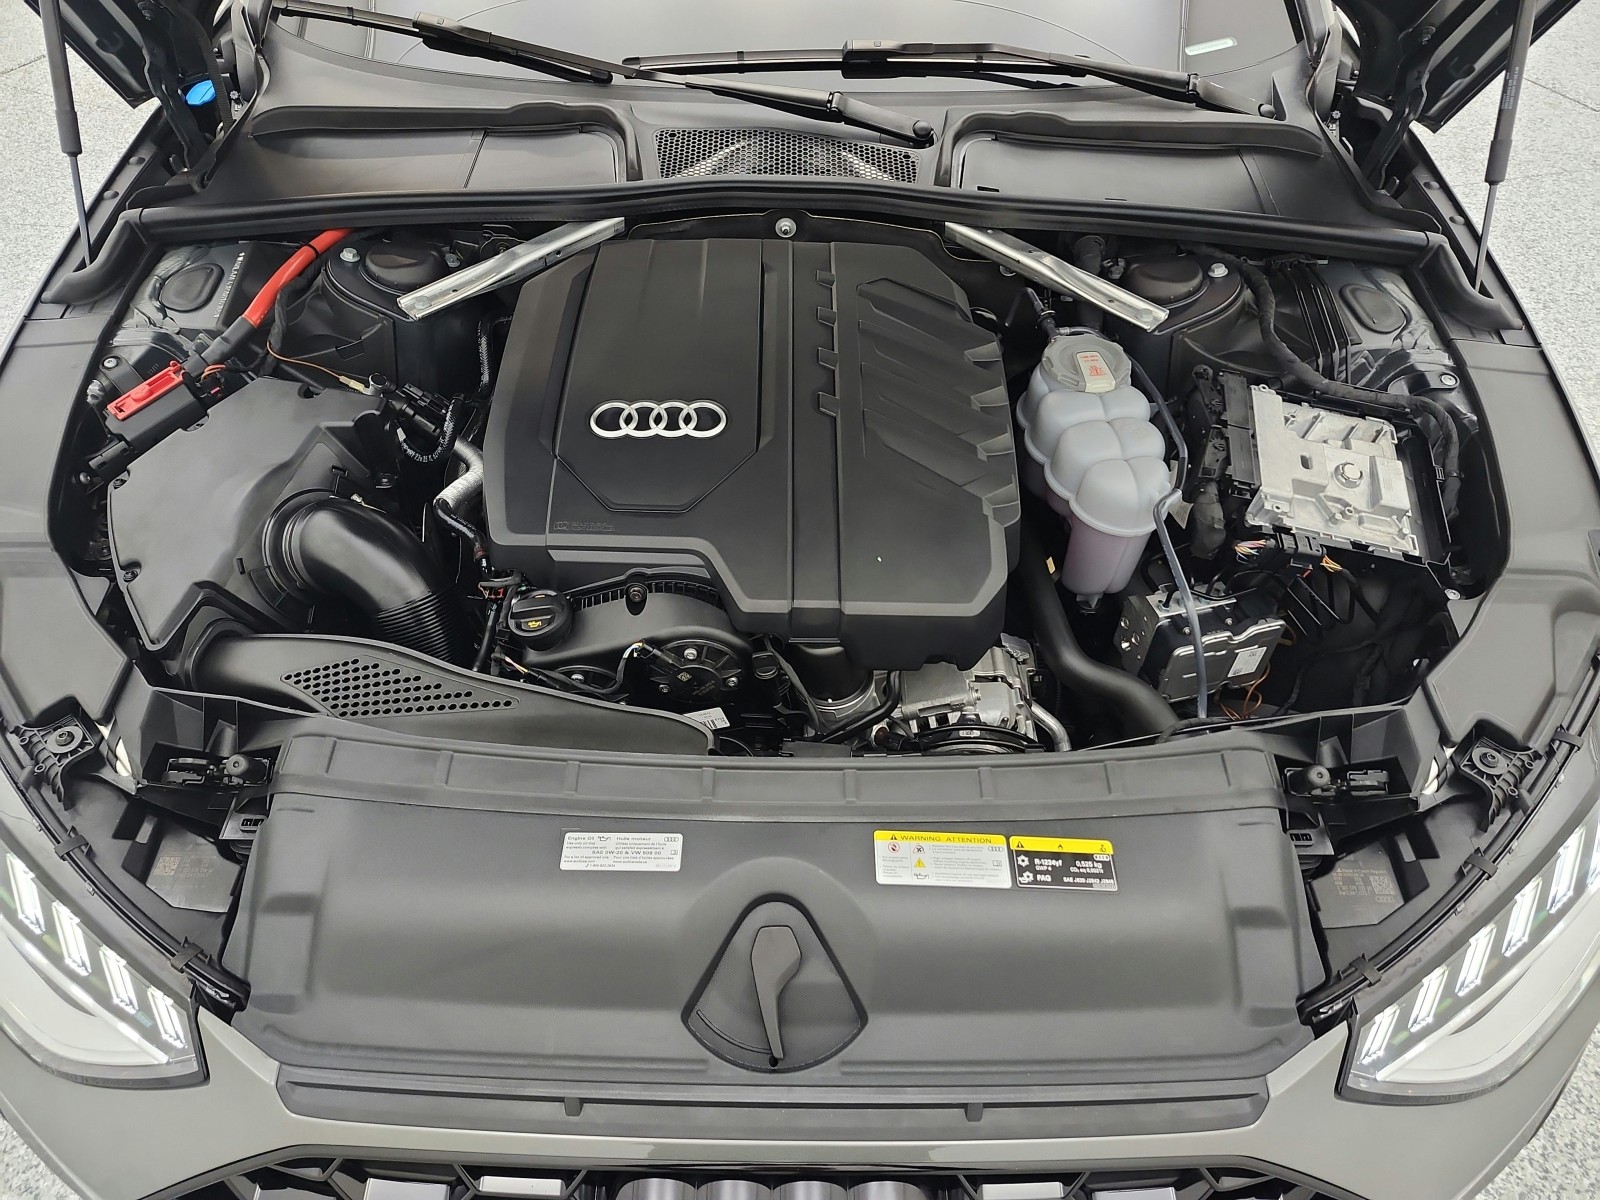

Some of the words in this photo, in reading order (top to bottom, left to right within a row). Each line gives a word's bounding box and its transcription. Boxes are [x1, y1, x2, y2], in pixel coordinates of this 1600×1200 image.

[945, 836, 992, 844] ATTENTION
[1034, 858, 1063, 867] R-1234yf
[1093, 861, 1103, 869] kg
[1036, 874, 1052, 882] PAG
